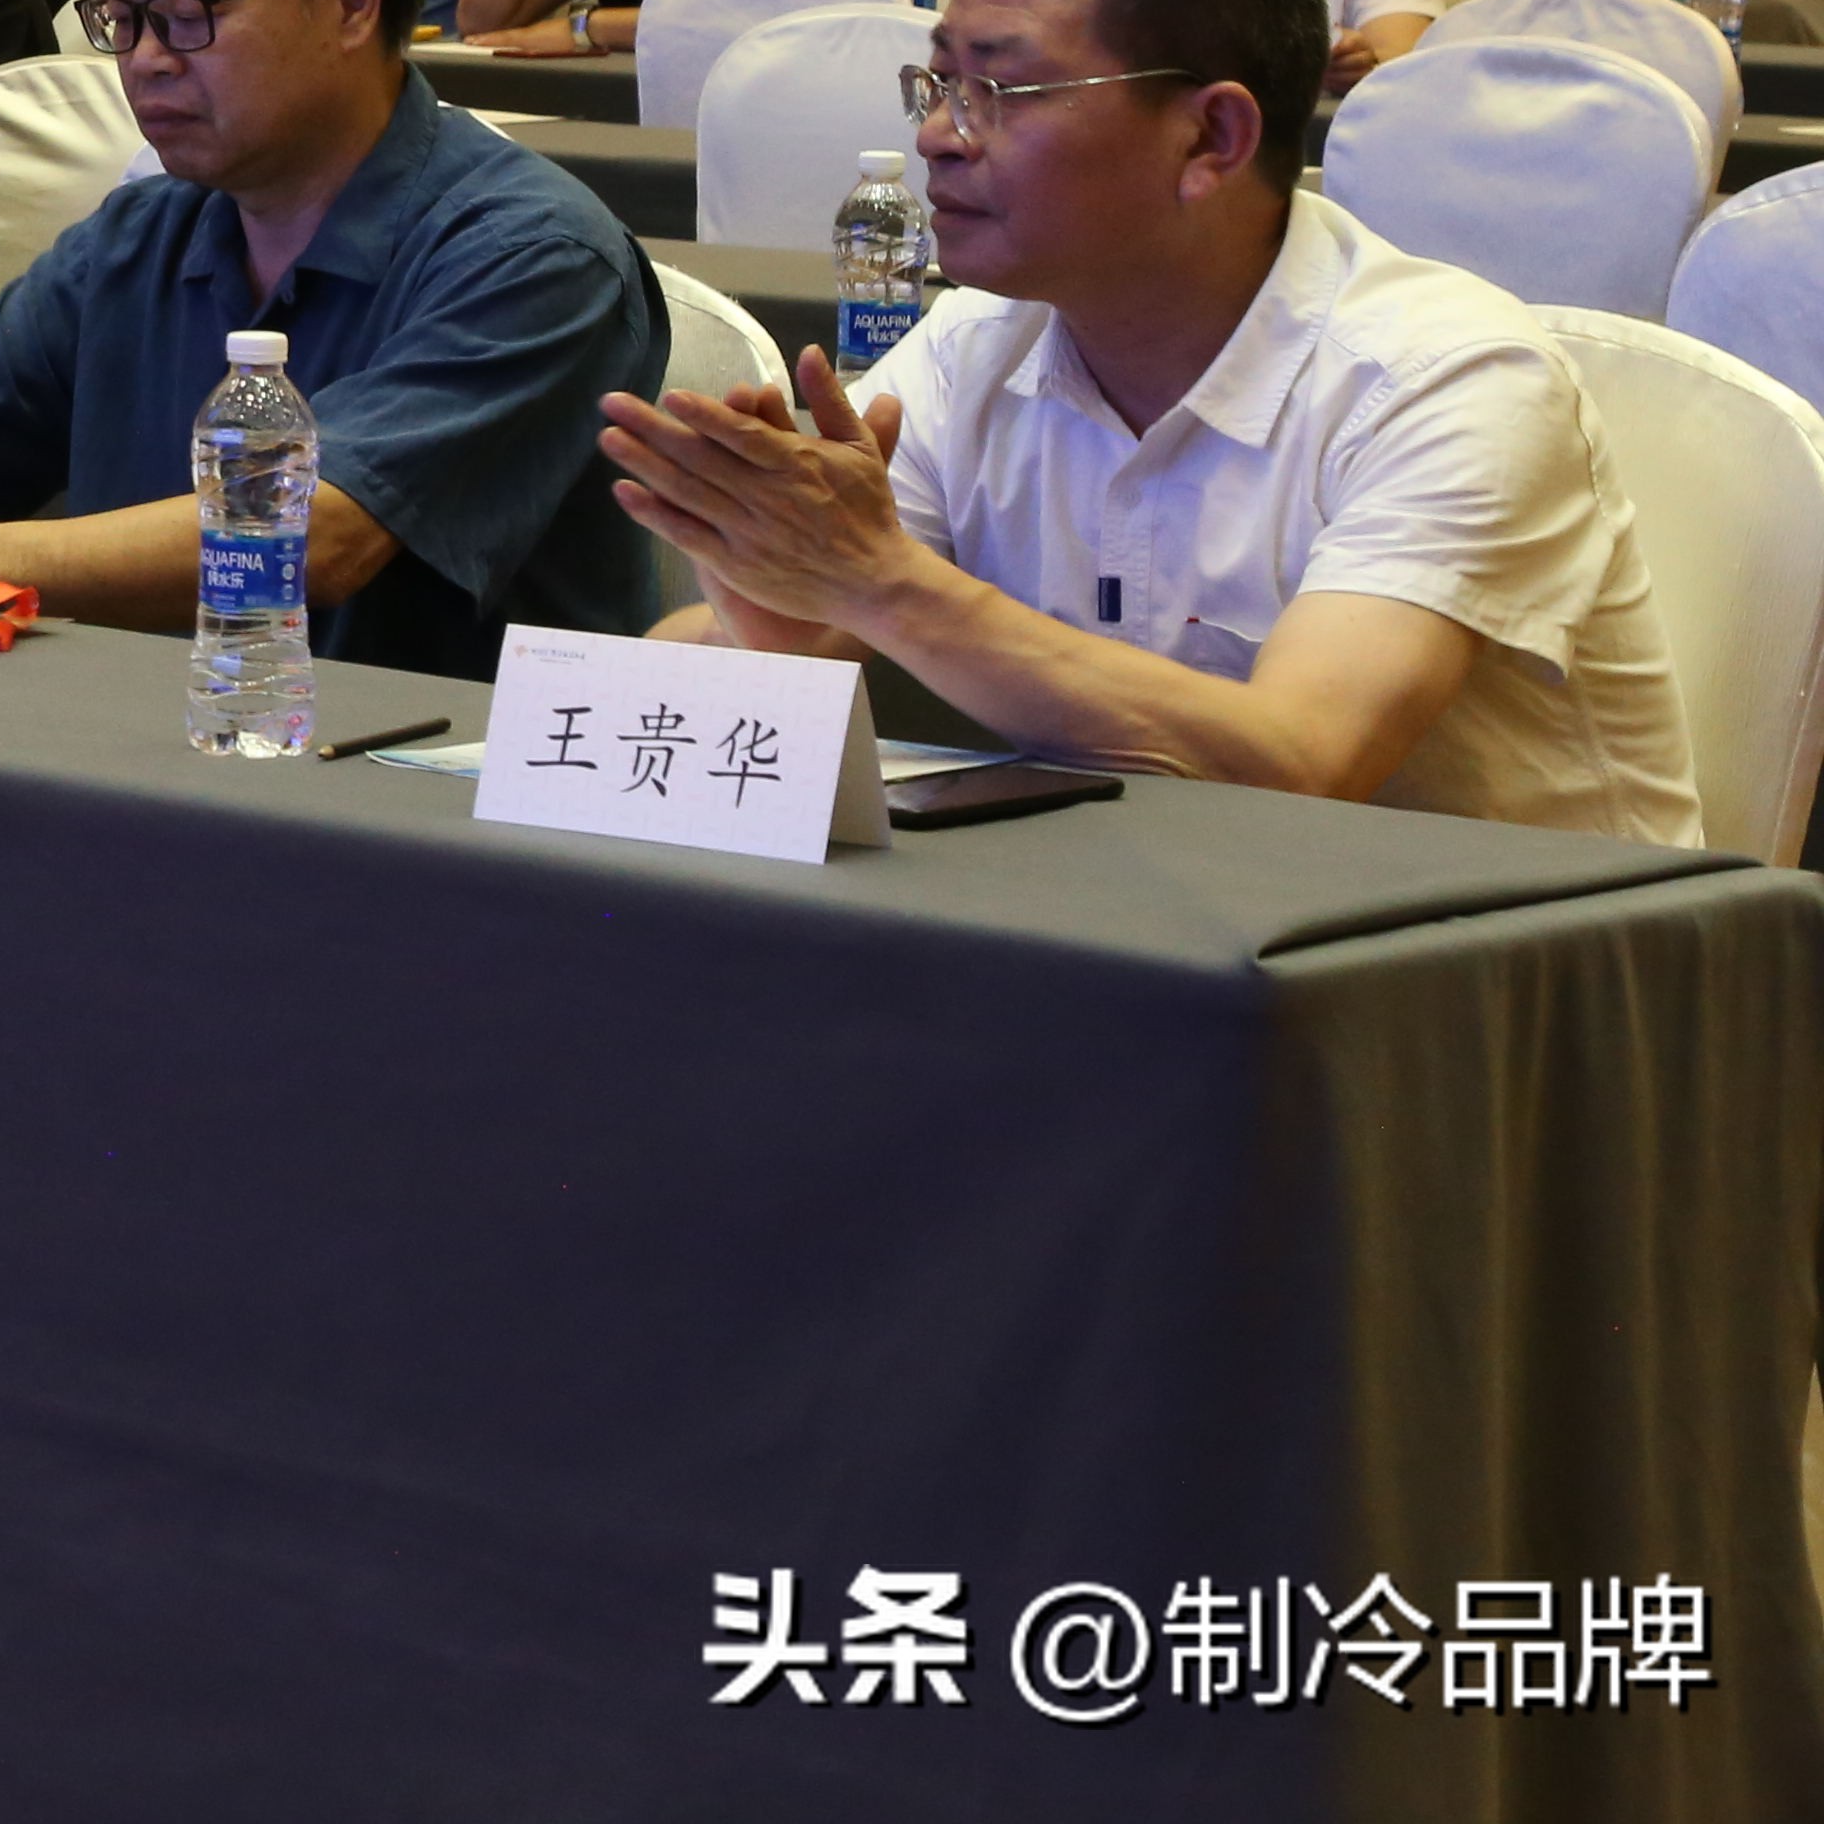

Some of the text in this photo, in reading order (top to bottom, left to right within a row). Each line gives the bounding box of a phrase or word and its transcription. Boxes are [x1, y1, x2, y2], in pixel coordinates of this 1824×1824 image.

[854, 314, 913, 330] AQUAFINA
[525, 702, 783, 810] 王贵华
